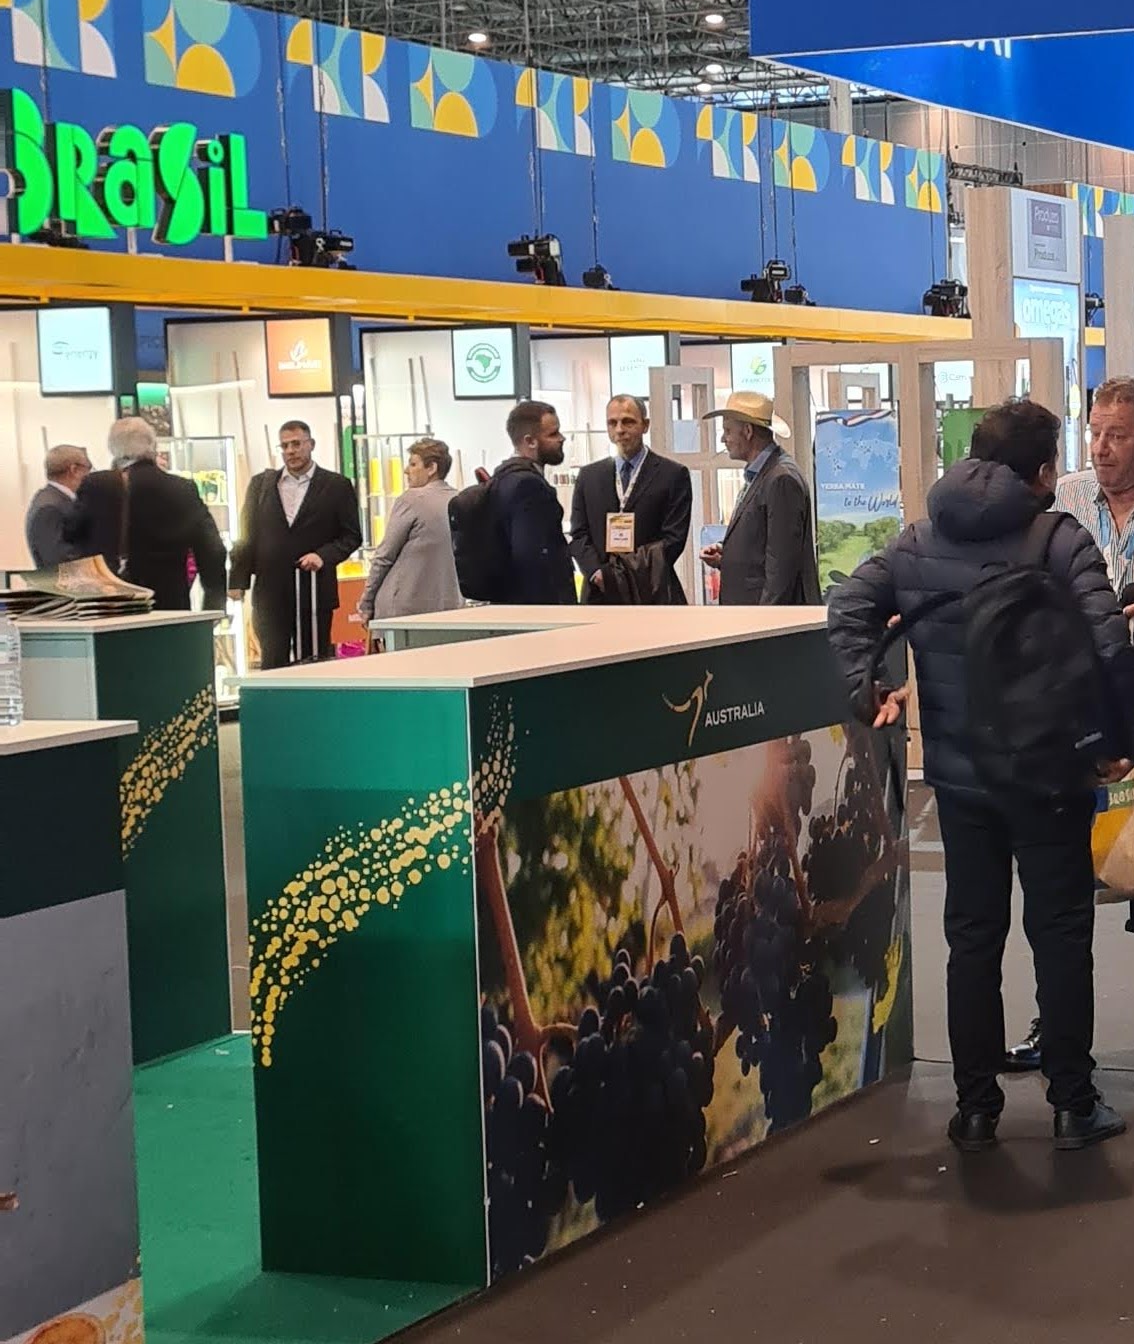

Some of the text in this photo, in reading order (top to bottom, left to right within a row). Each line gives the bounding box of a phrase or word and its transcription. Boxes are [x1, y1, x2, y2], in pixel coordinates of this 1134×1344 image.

[854, 495, 867, 507] the
[868, 493, 899, 512] World
[704, 700, 766, 728] AUSTRALIA
